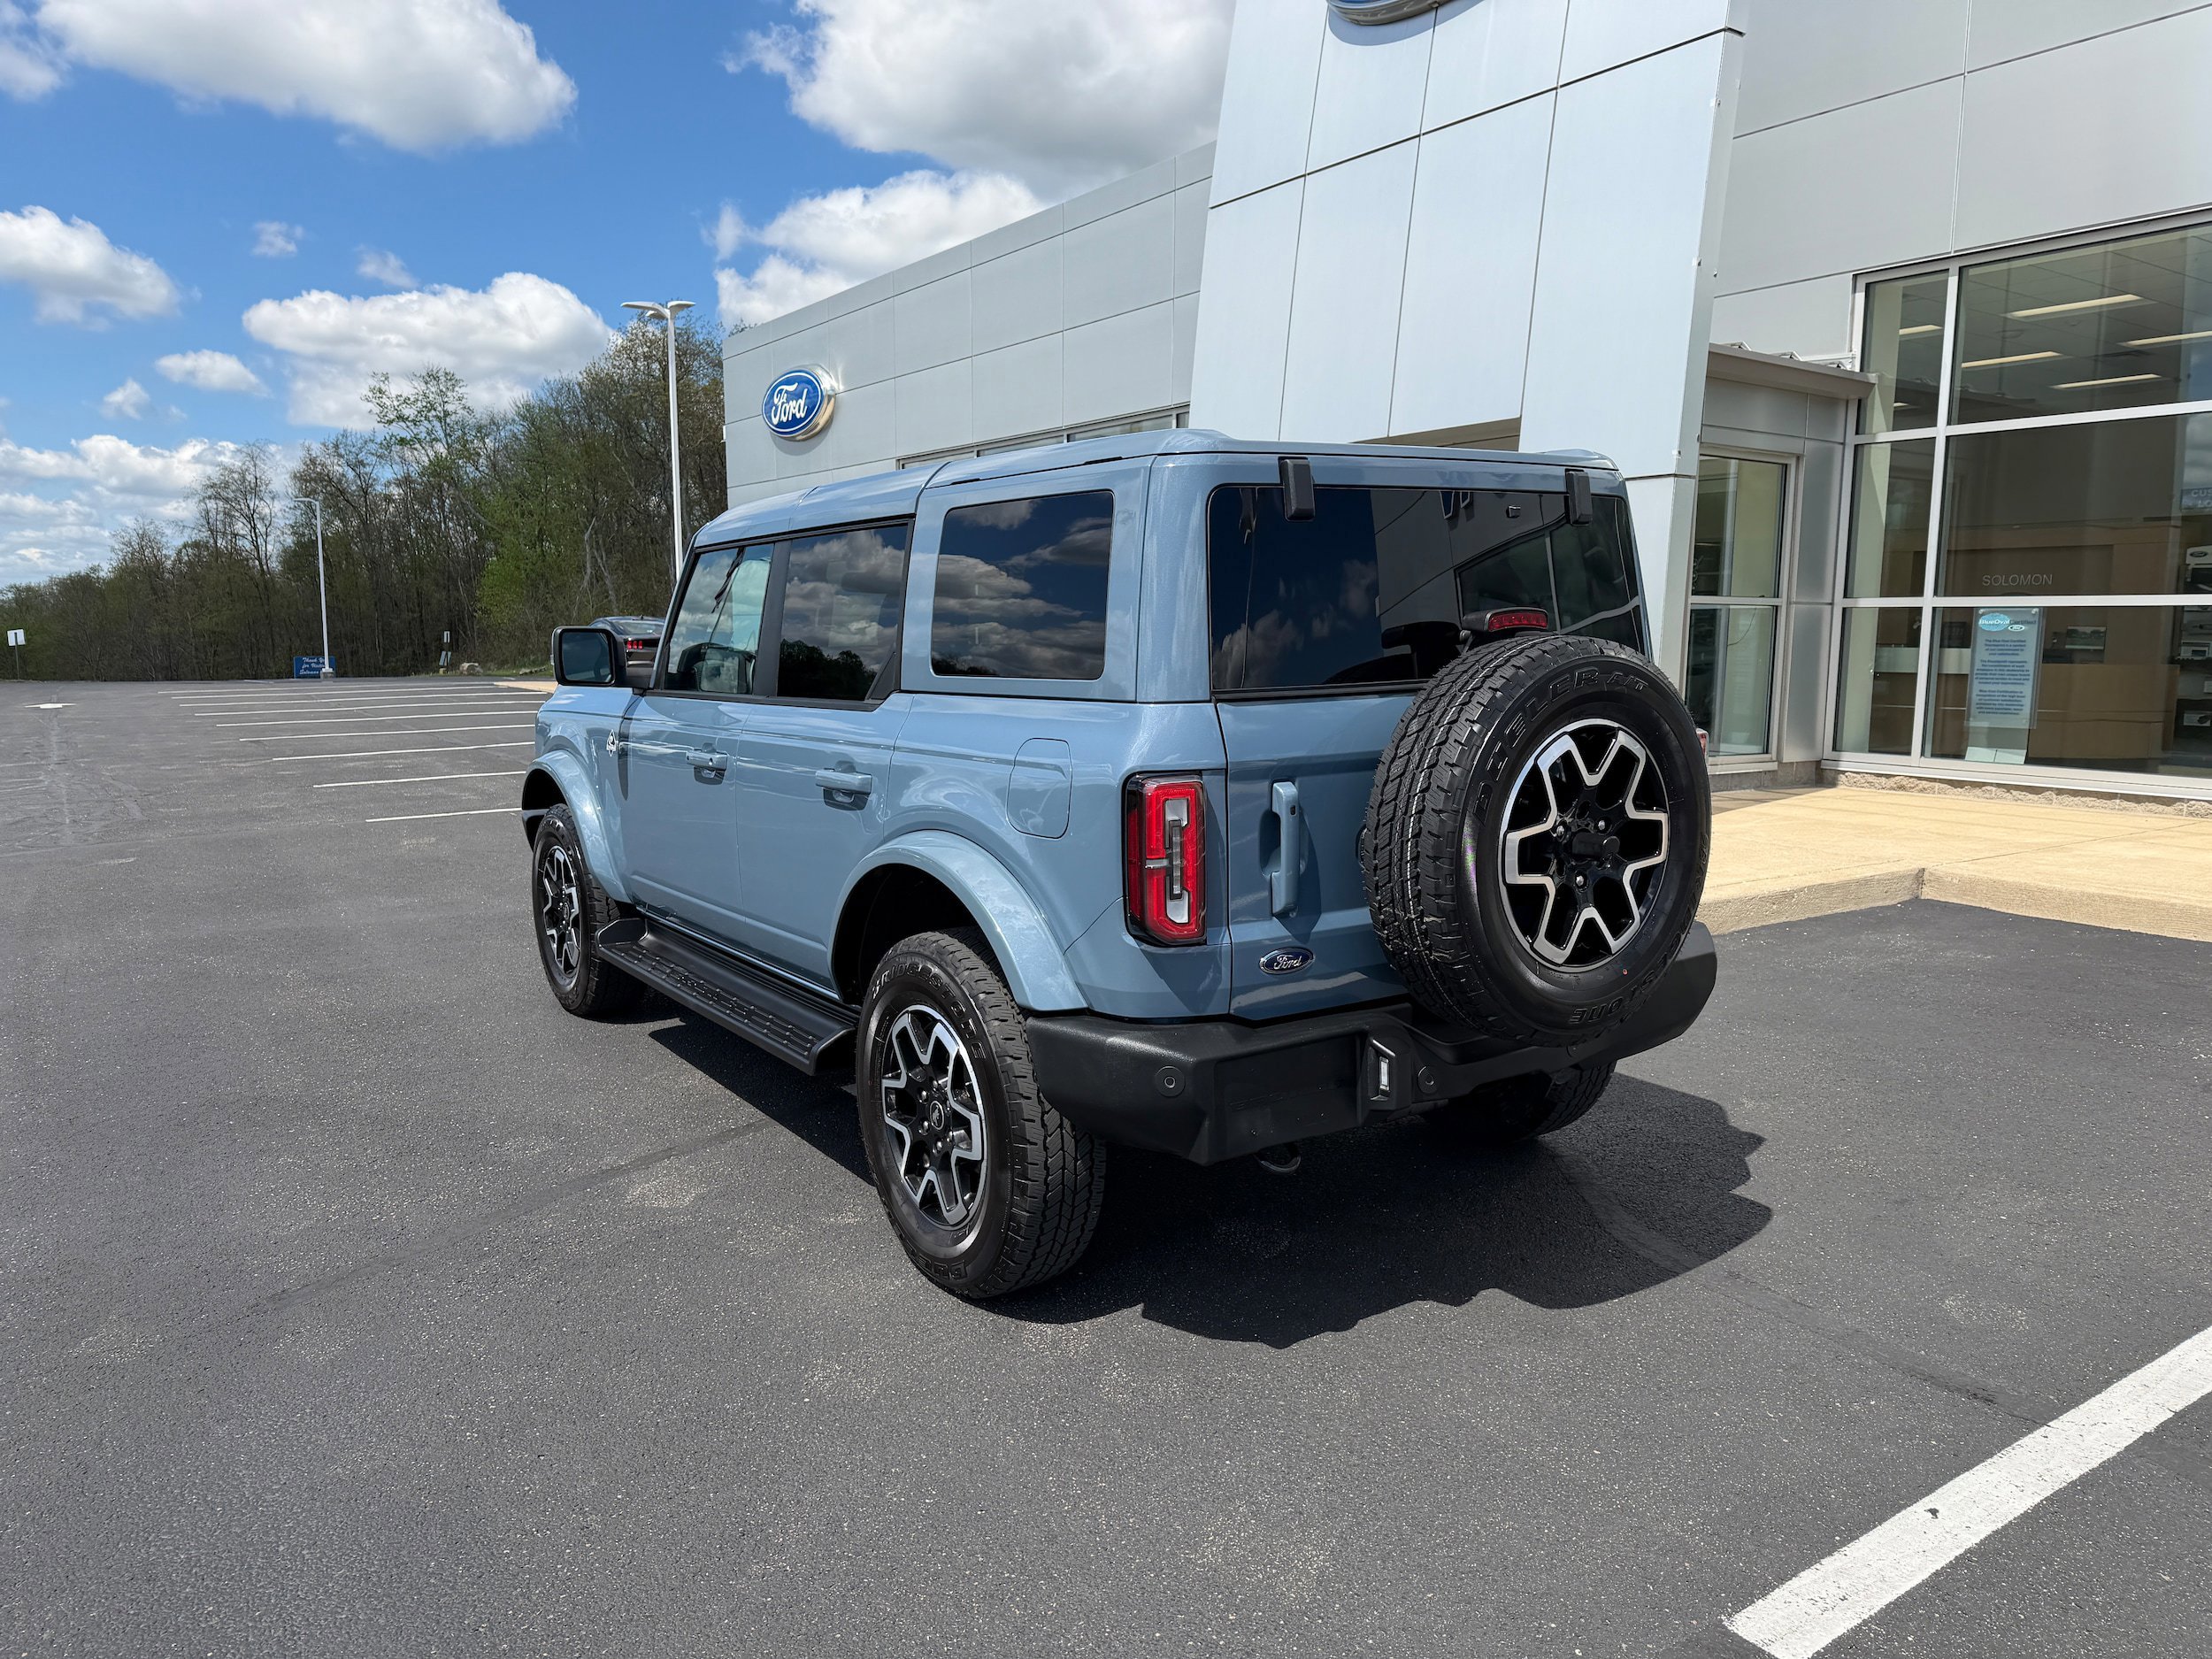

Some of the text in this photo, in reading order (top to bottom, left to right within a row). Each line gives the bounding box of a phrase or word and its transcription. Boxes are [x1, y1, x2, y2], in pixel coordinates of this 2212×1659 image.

[771, 382, 808, 425] Ford
[1982, 573, 2053, 586] SOLOMON
[1273, 954, 1302, 970] Ford
